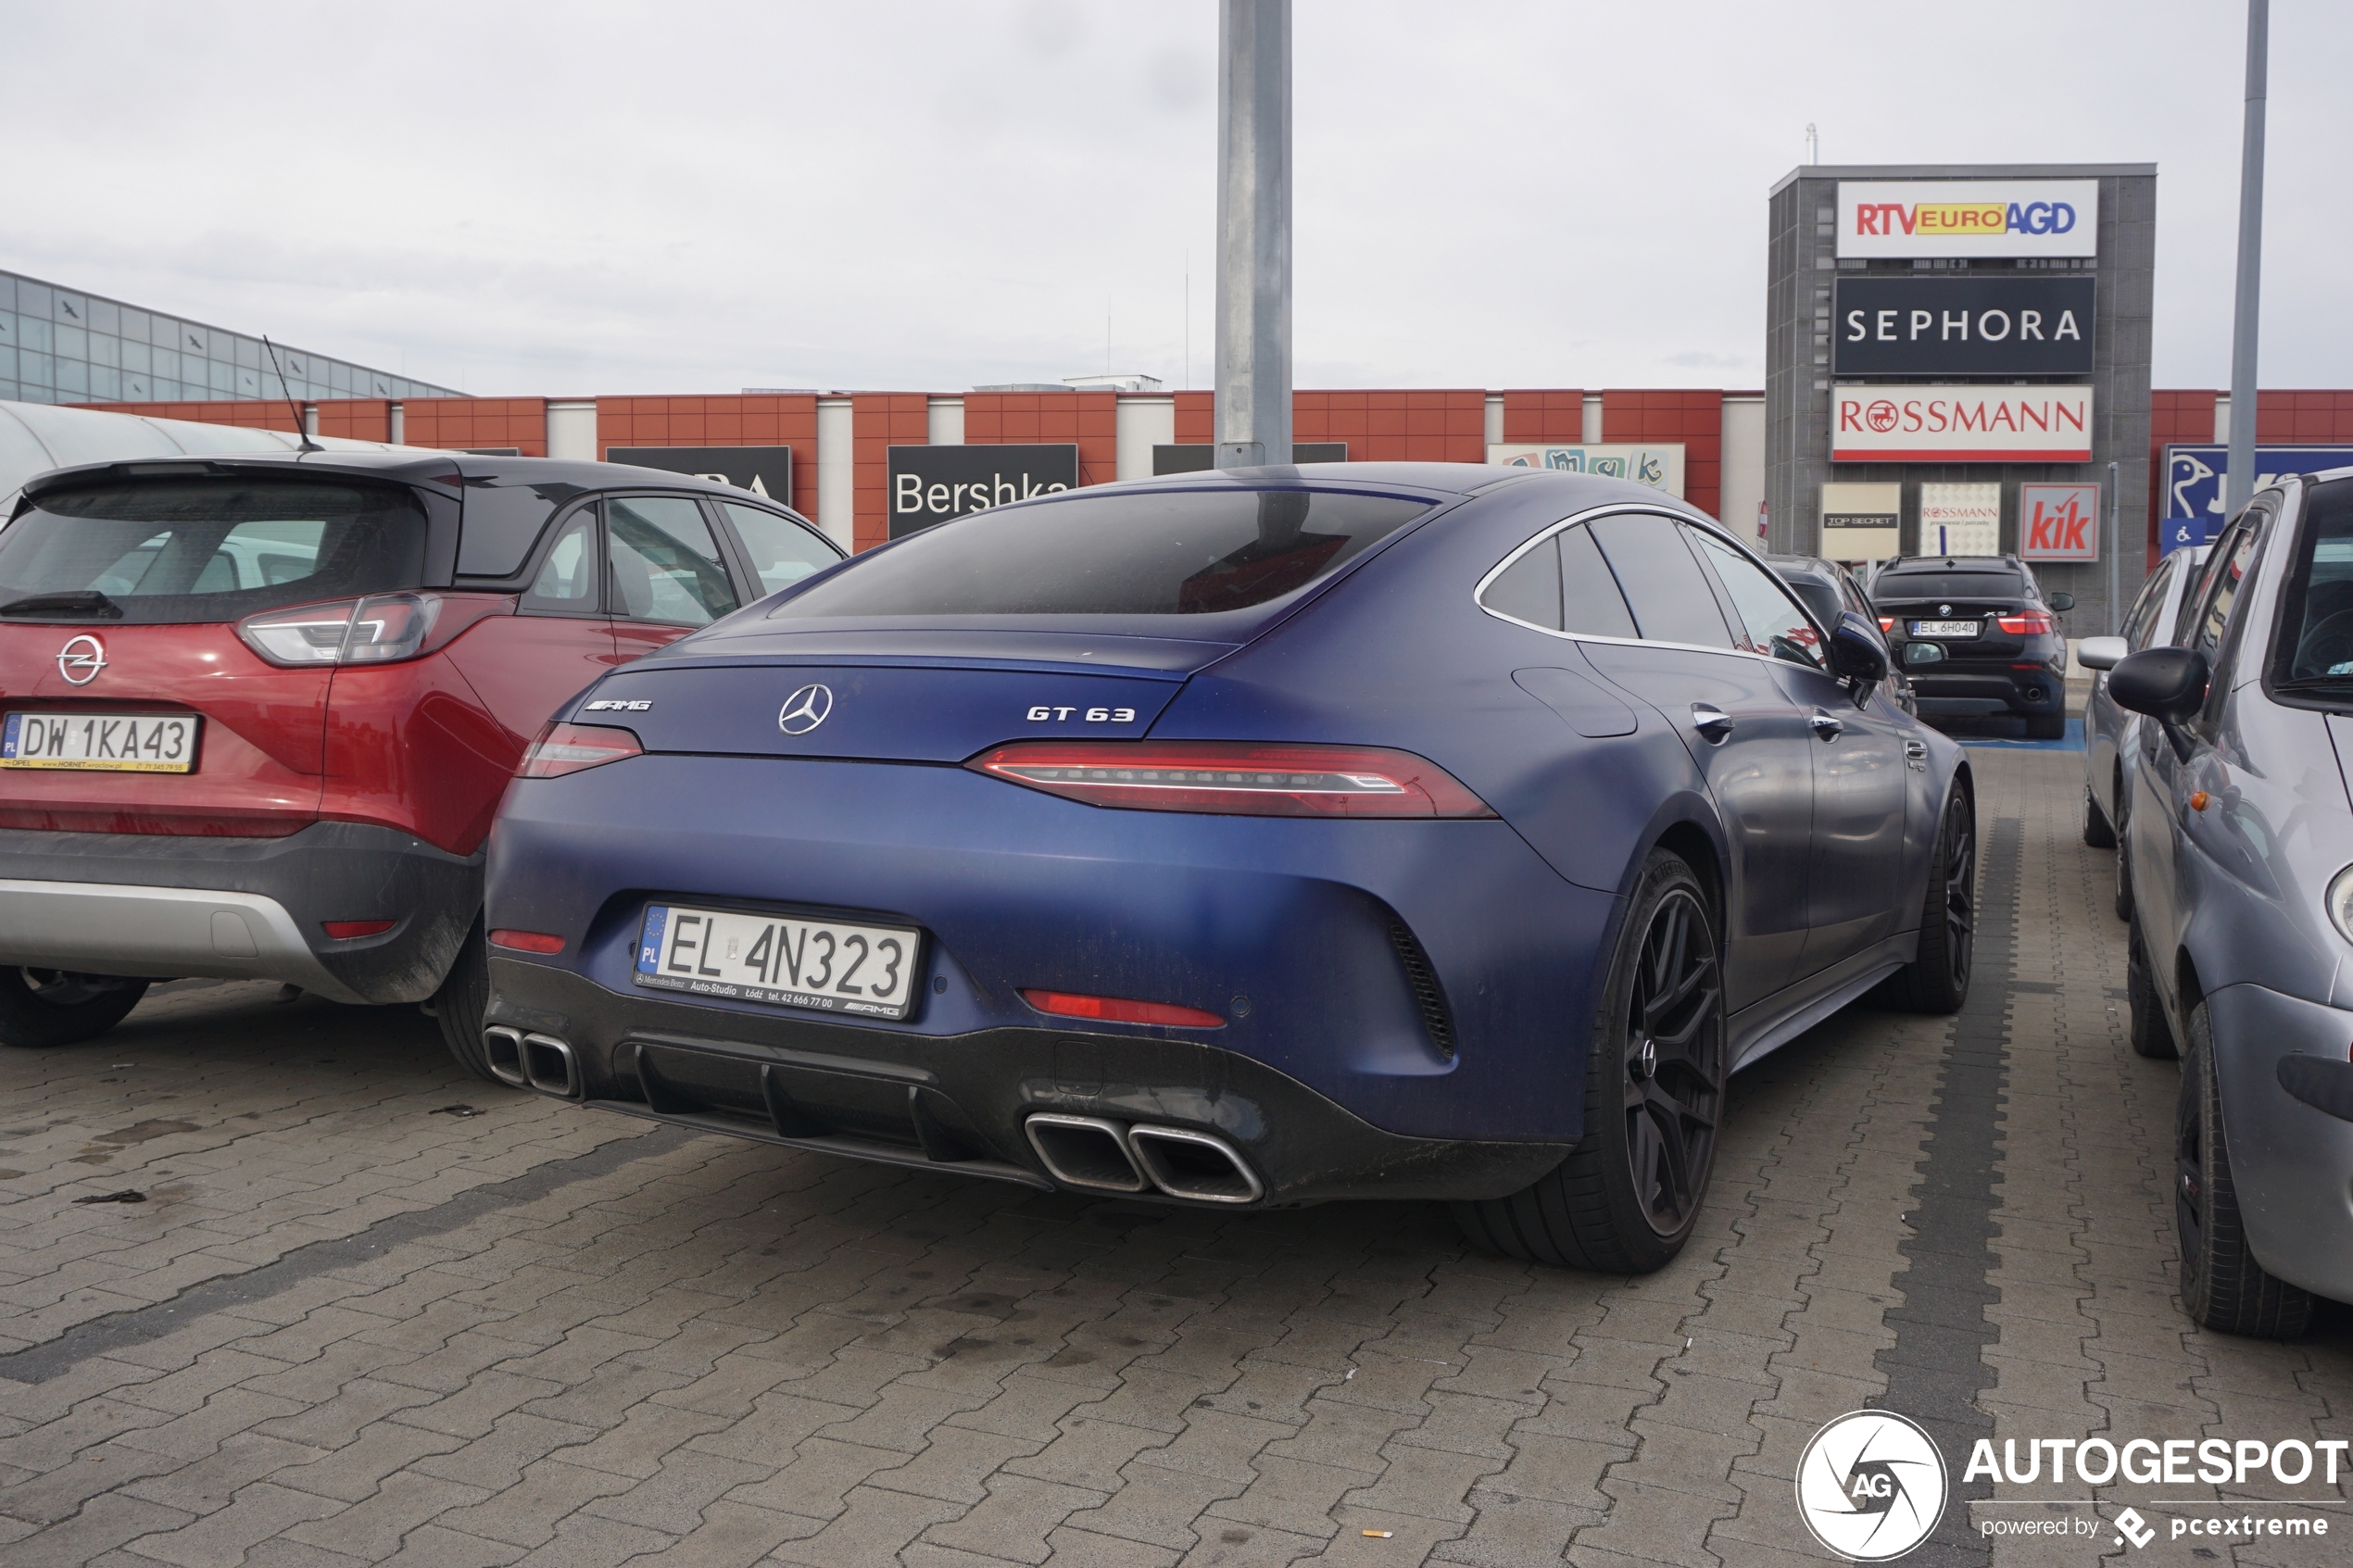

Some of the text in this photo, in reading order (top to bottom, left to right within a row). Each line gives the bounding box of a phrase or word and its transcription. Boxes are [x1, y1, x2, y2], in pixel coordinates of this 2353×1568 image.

[1856, 202, 2076, 235] RTV EURO AGD
[1847, 309, 2082, 342] SEPHORA
[1840, 399, 2084, 433] ROSSMANN
[897, 473, 1068, 513] Bershk
[1828, 517, 1850, 525] TOP
[1851, 517, 1892, 525] SECRET
[1923, 508, 1997, 518] ROSSMANN
[1920, 622, 1975, 633] EL 6H040
[1026, 707, 1136, 722] GT 63
[5, 742, 16, 753] PL
[23, 719, 184, 759] DW 1KA43
[642, 947, 657, 963] PL
[667, 915, 902, 997] EL 4N323
[690, 981, 736, 996] Auto-Studio
[745, 988, 763, 998] Łódź
[768, 992, 780, 1001] tel.
[781, 994, 792, 1003] 42
[793, 996, 809, 1005] 666
[810, 997, 821, 1007] 77
[822, 998, 833, 1008] 00
